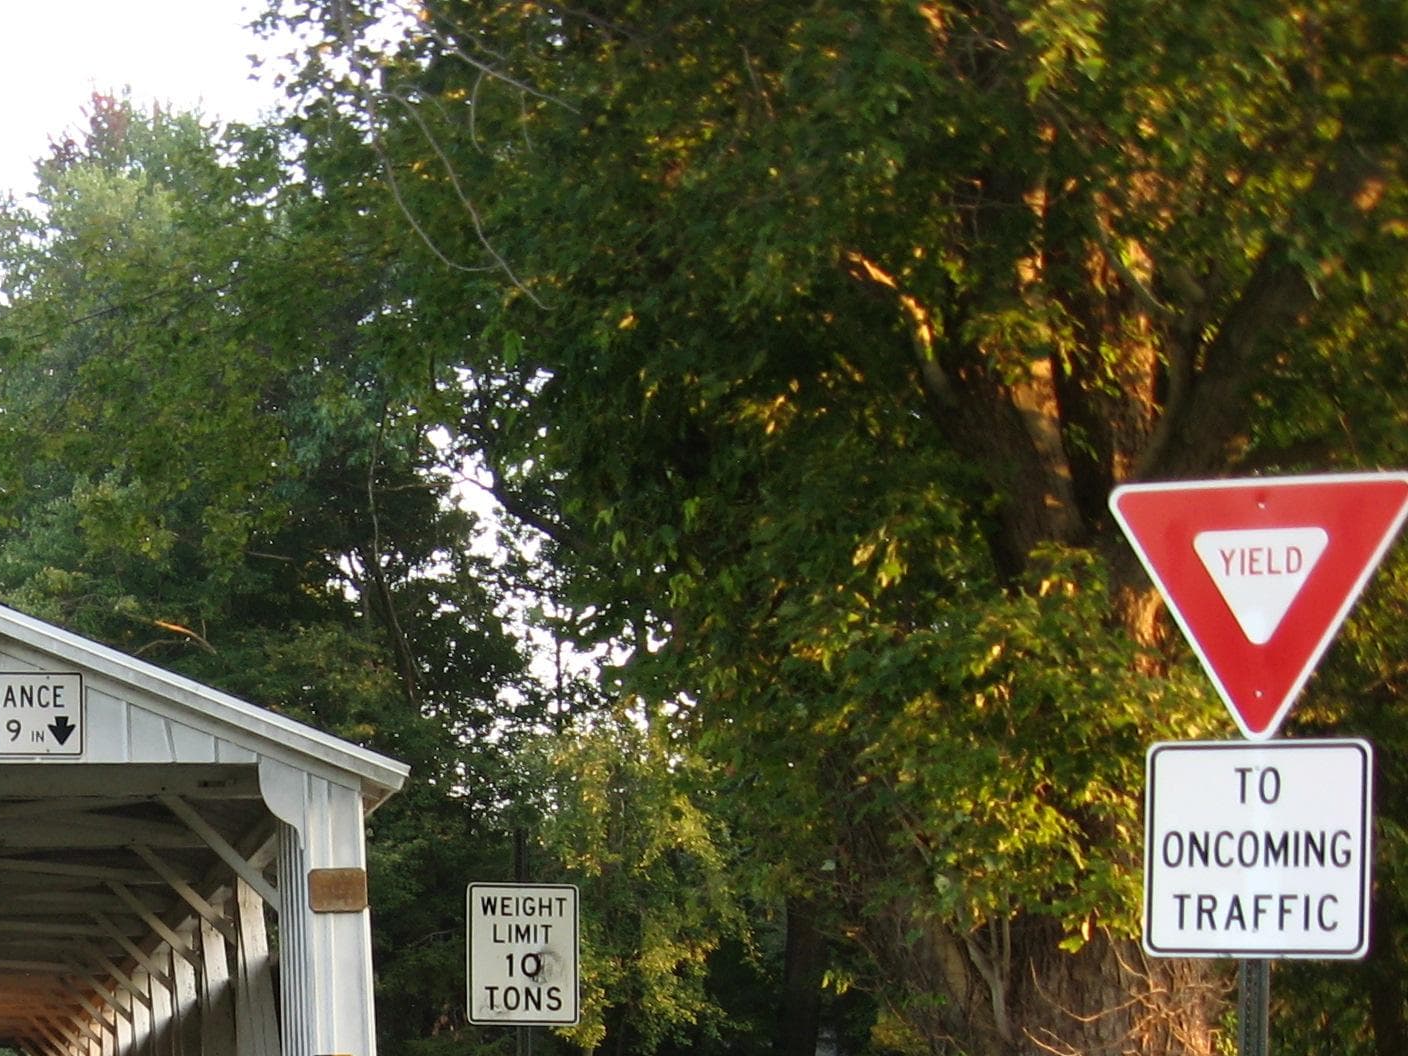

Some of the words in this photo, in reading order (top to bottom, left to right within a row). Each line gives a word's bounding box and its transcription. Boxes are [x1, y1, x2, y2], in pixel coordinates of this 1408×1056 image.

[1217, 546, 1303, 576] YIELD
[6, 719, 22, 742] 9
[31, 730, 45, 742] IN
[1234, 766, 1282, 805] TO
[1162, 829, 1353, 869] ONCOMING
[481, 896, 568, 918] WEIGHT
[1173, 893, 1339, 933] TRAFFIC
[492, 924, 553, 944] LIMIT
[506, 953, 542, 977] 10
[485, 986, 562, 1011] TONS
